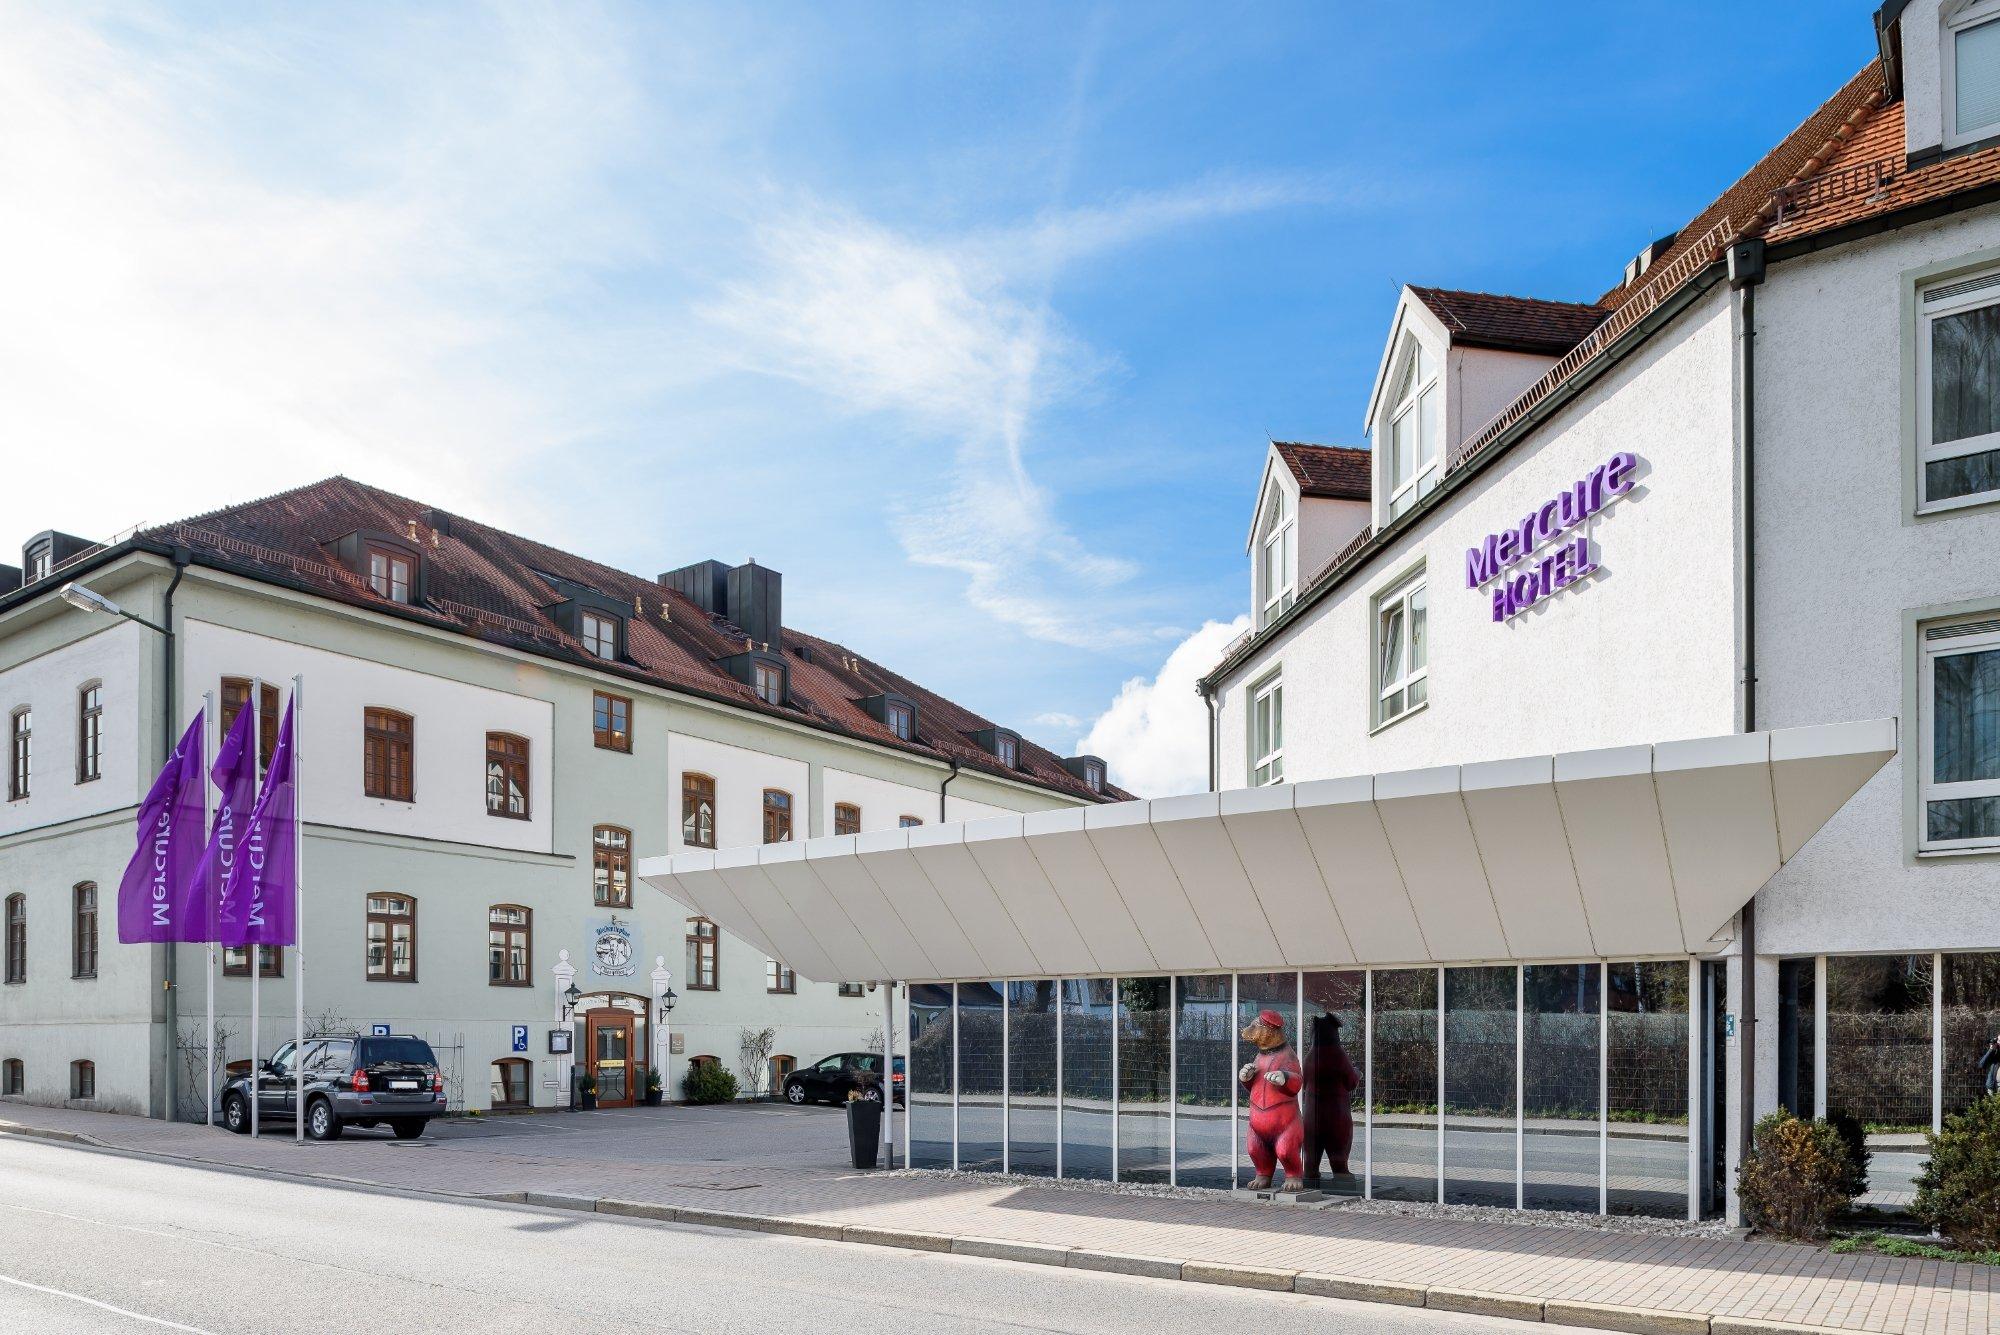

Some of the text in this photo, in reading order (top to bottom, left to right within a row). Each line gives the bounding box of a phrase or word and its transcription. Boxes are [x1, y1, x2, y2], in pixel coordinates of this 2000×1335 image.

[1466, 452, 1637, 589] Mercure
[1493, 537, 1598, 622] HOTEL
[514, 1027, 525, 1044] P
